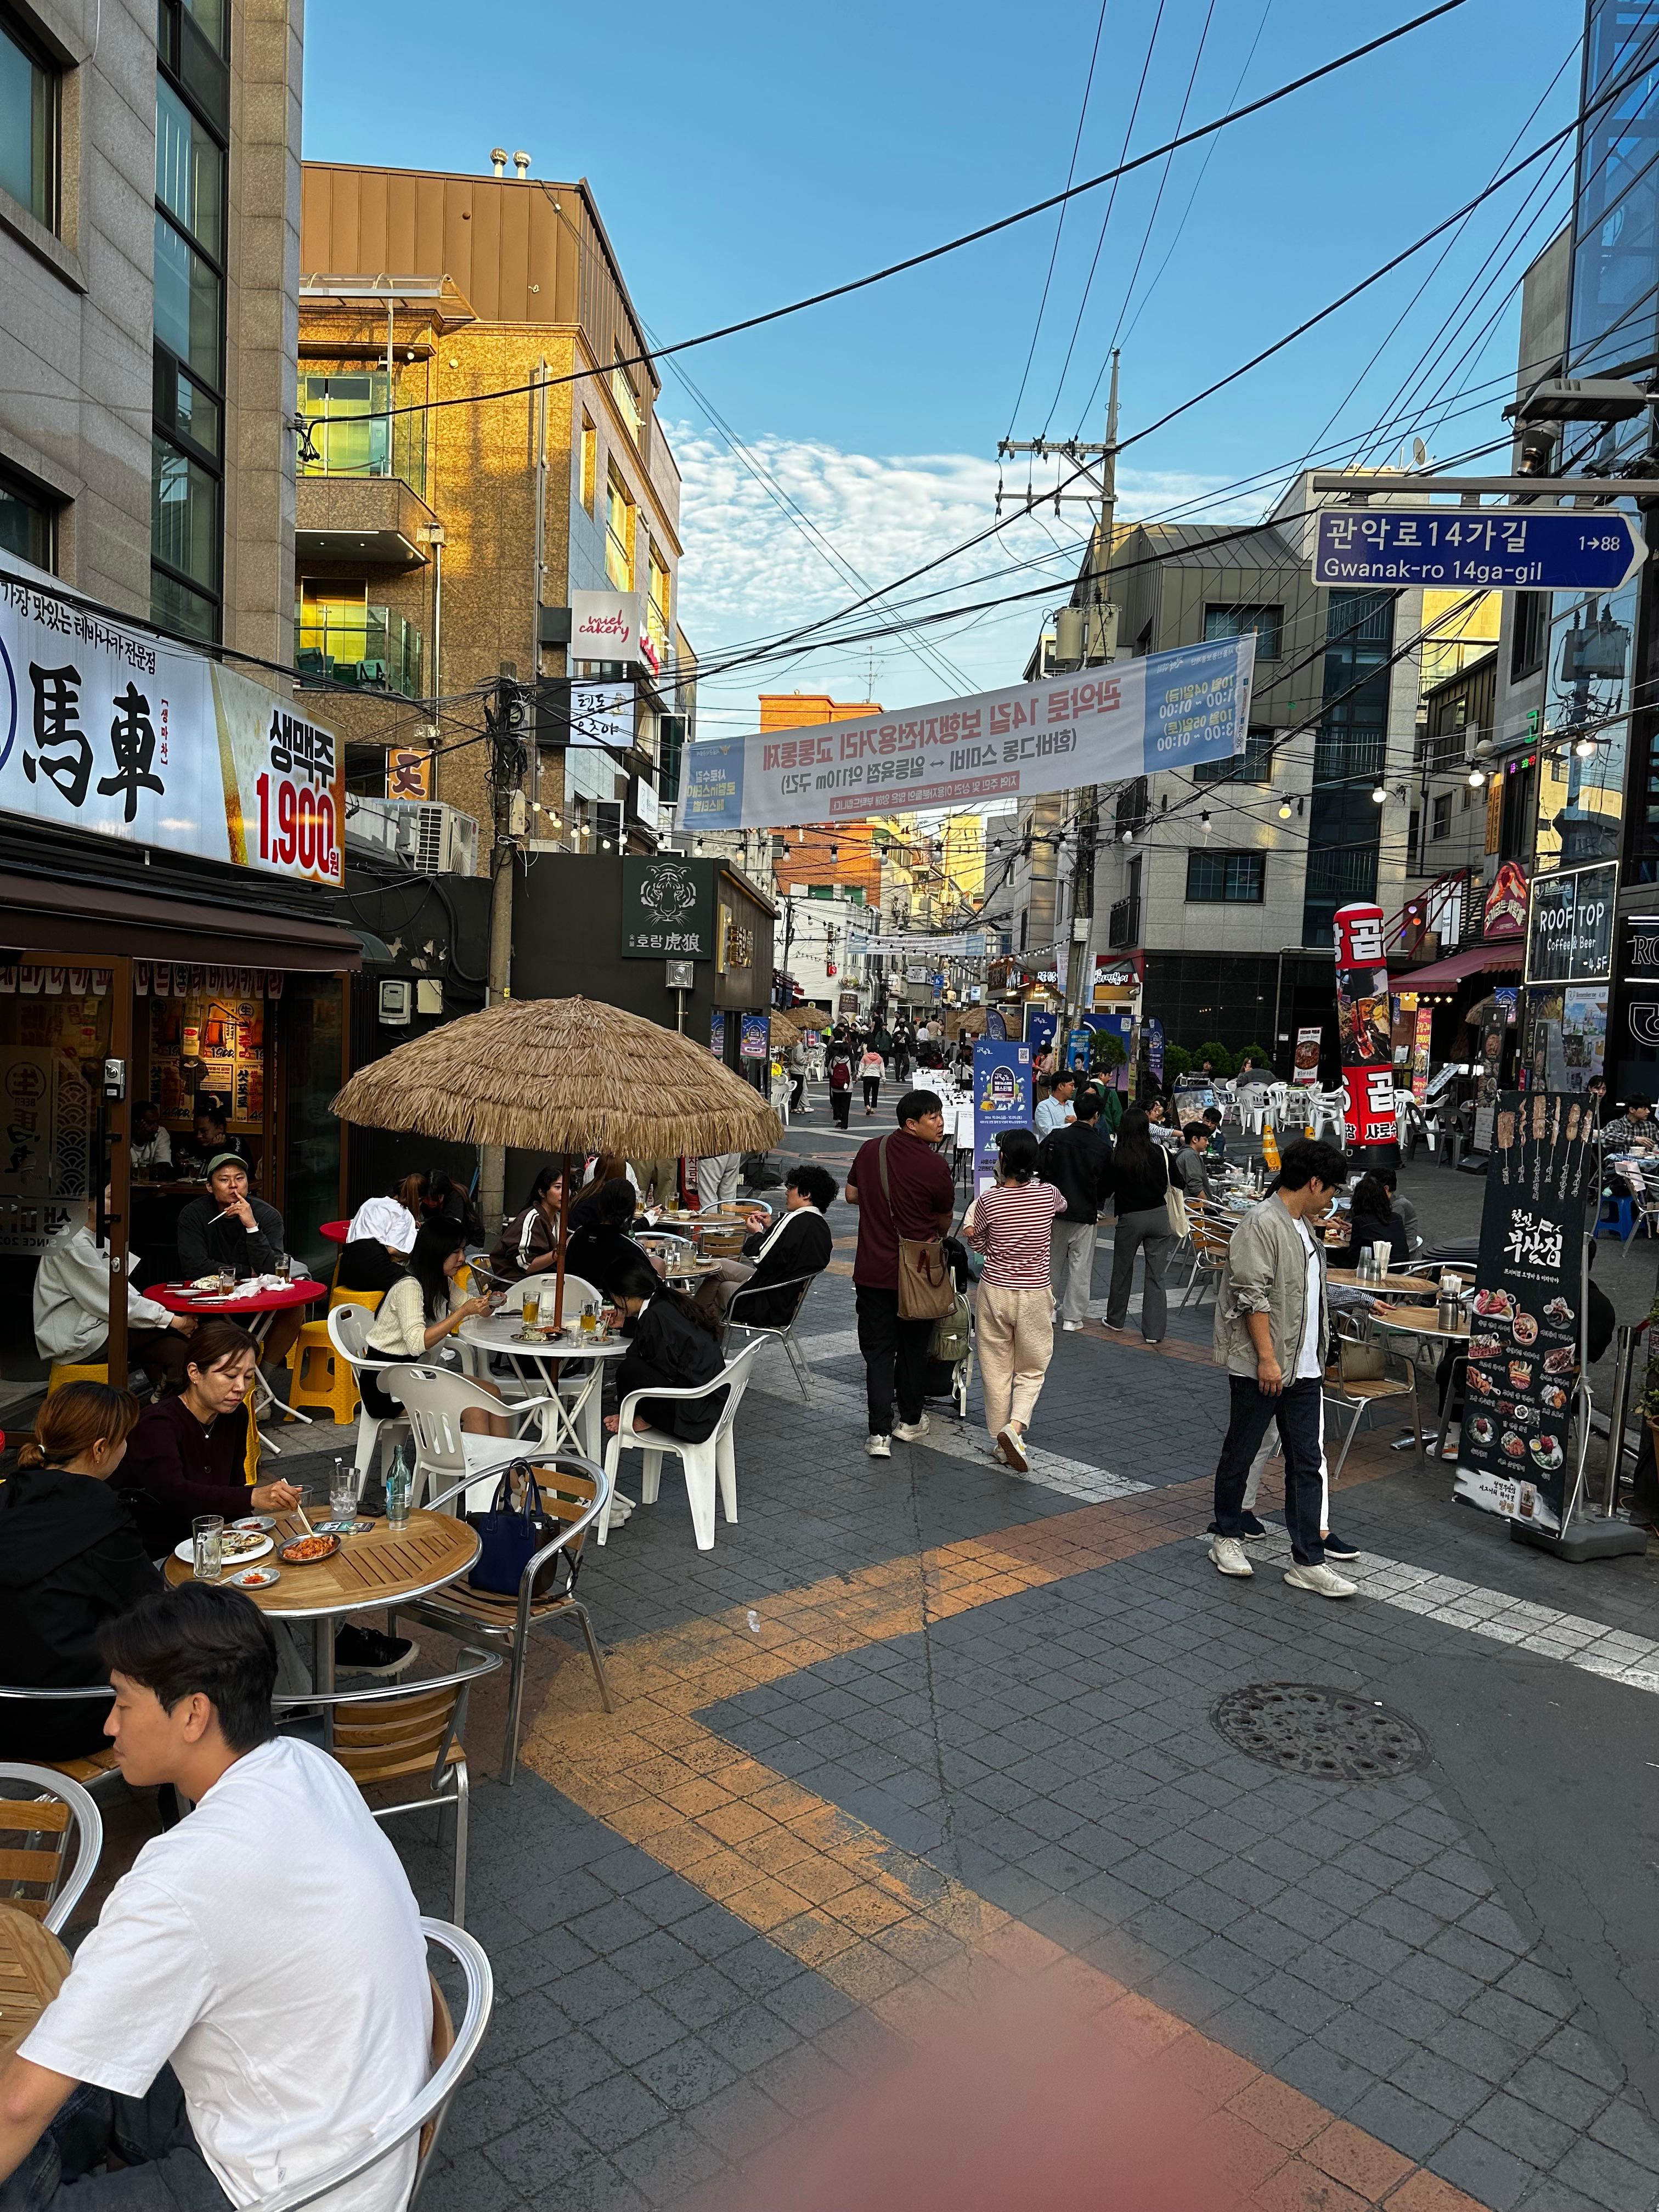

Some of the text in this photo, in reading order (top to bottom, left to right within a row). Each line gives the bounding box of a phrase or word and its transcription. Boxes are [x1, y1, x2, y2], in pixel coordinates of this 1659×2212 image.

[1326, 517, 1527, 553] 관악로14가길
[1324, 558, 1542, 584] Gwanak-ro 14ga-gil
[588, 609, 624, 627] miel
[33, 595, 72, 636] 맛있는
[124, 641, 156, 675] 전문점
[579, 622, 629, 643] cakery
[22, 660, 165, 823] 馬車
[269, 709, 335, 789] 생맥주
[1539, 902, 1605, 933] ROOF TOP
[636, 933, 664, 949] 호랑
[664, 932, 704, 953] 虎狼
[1547, 935, 1596, 951] Coffee & Beer
[1511, 1209, 1537, 1231] 철길
[1503, 1229, 1563, 1268] 부산집
